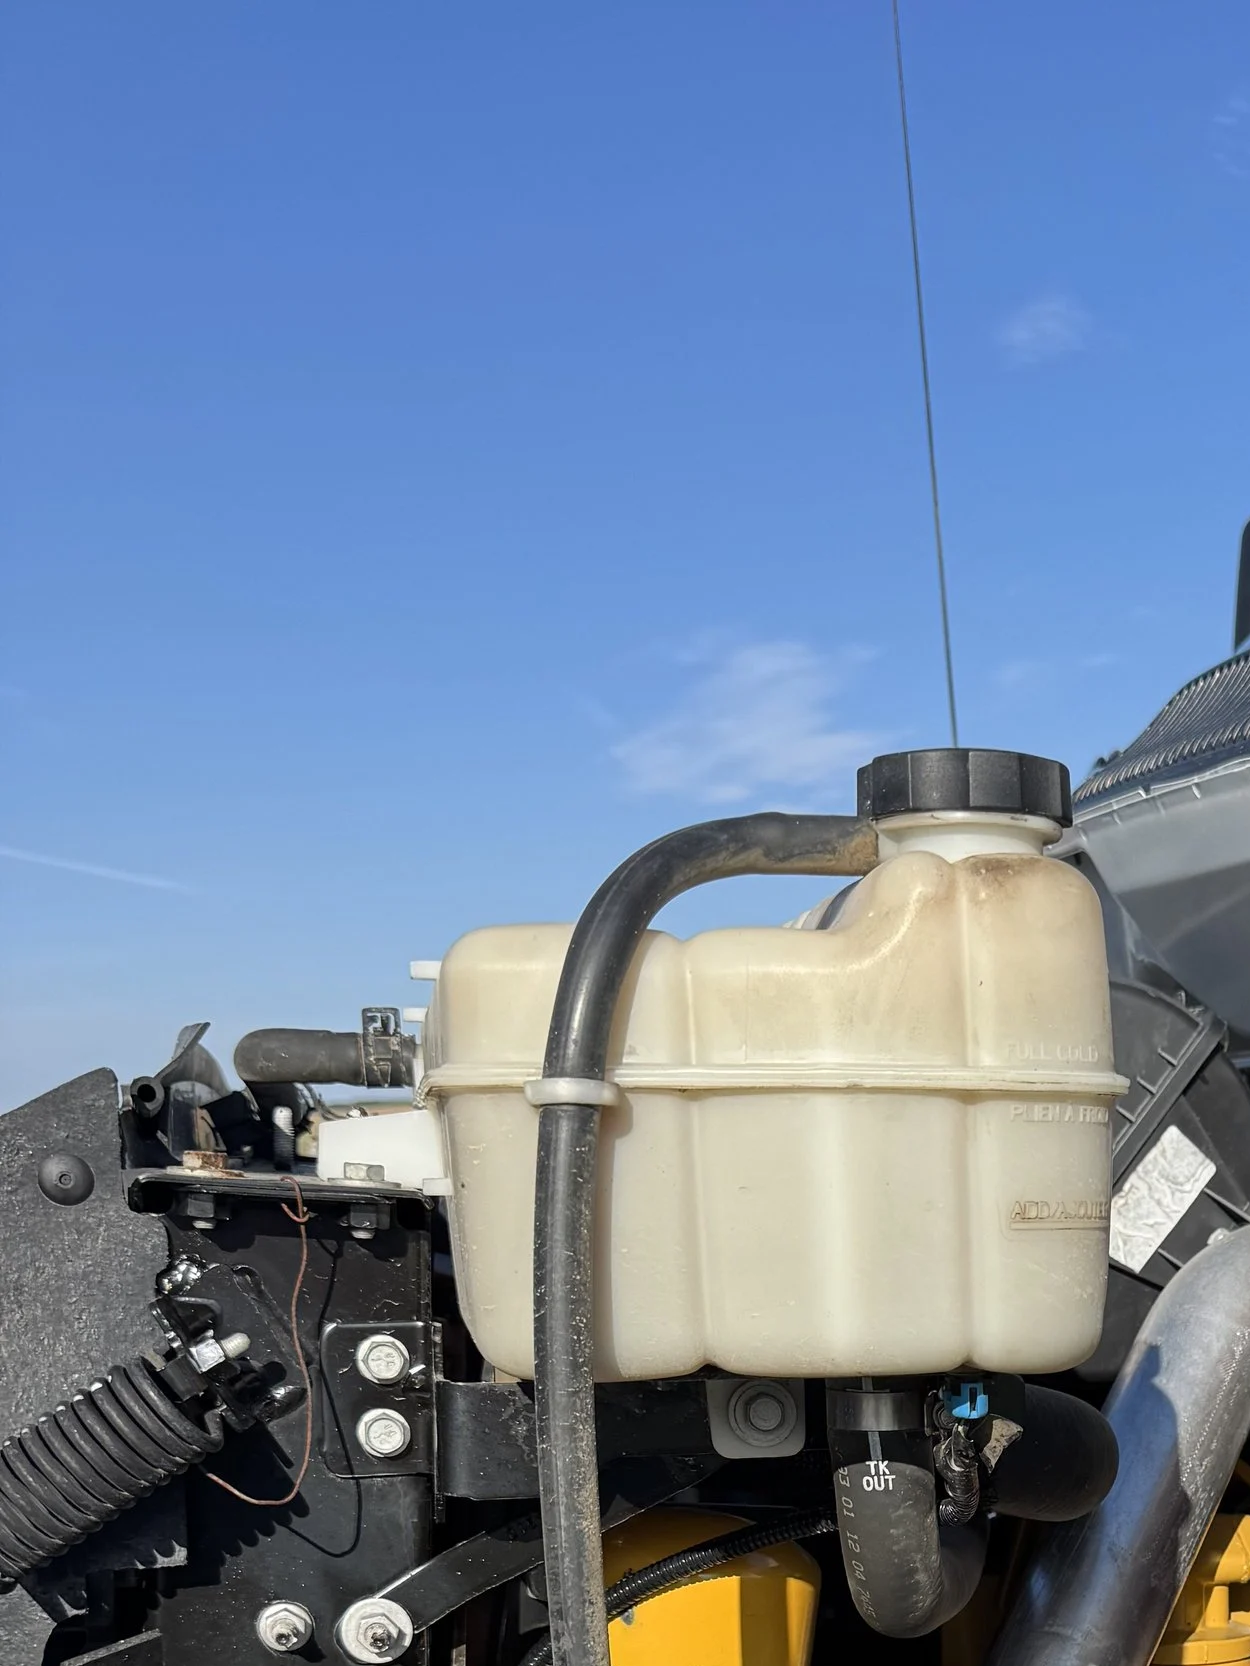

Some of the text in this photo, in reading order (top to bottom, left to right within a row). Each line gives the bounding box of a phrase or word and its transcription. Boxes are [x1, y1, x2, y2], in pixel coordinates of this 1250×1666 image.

[1007, 1042, 1099, 1062] FULL COLD
[865, 1461, 890, 1475] TK
[862, 1475, 896, 1491] OUT
[842, 1497, 855, 1518] 01
[846, 1530, 860, 1553] 12
